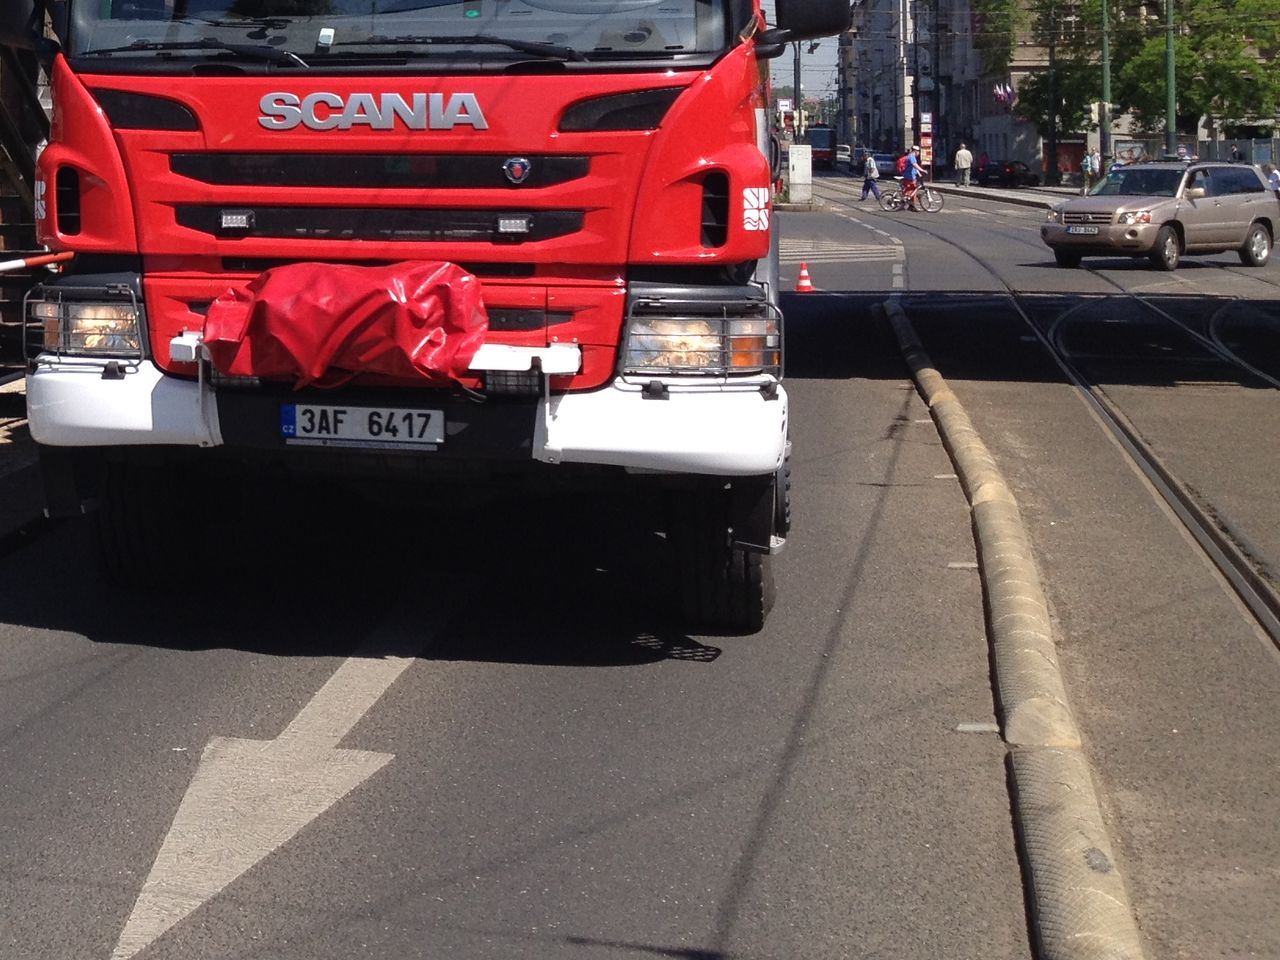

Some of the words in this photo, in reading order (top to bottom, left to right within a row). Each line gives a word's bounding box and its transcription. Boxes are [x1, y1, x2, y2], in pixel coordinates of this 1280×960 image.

[257, 91, 489, 131] SCANIA
[282, 424, 295, 433] CZ
[301, 408, 348, 435] 3AF
[368, 411, 432, 439] 6417
